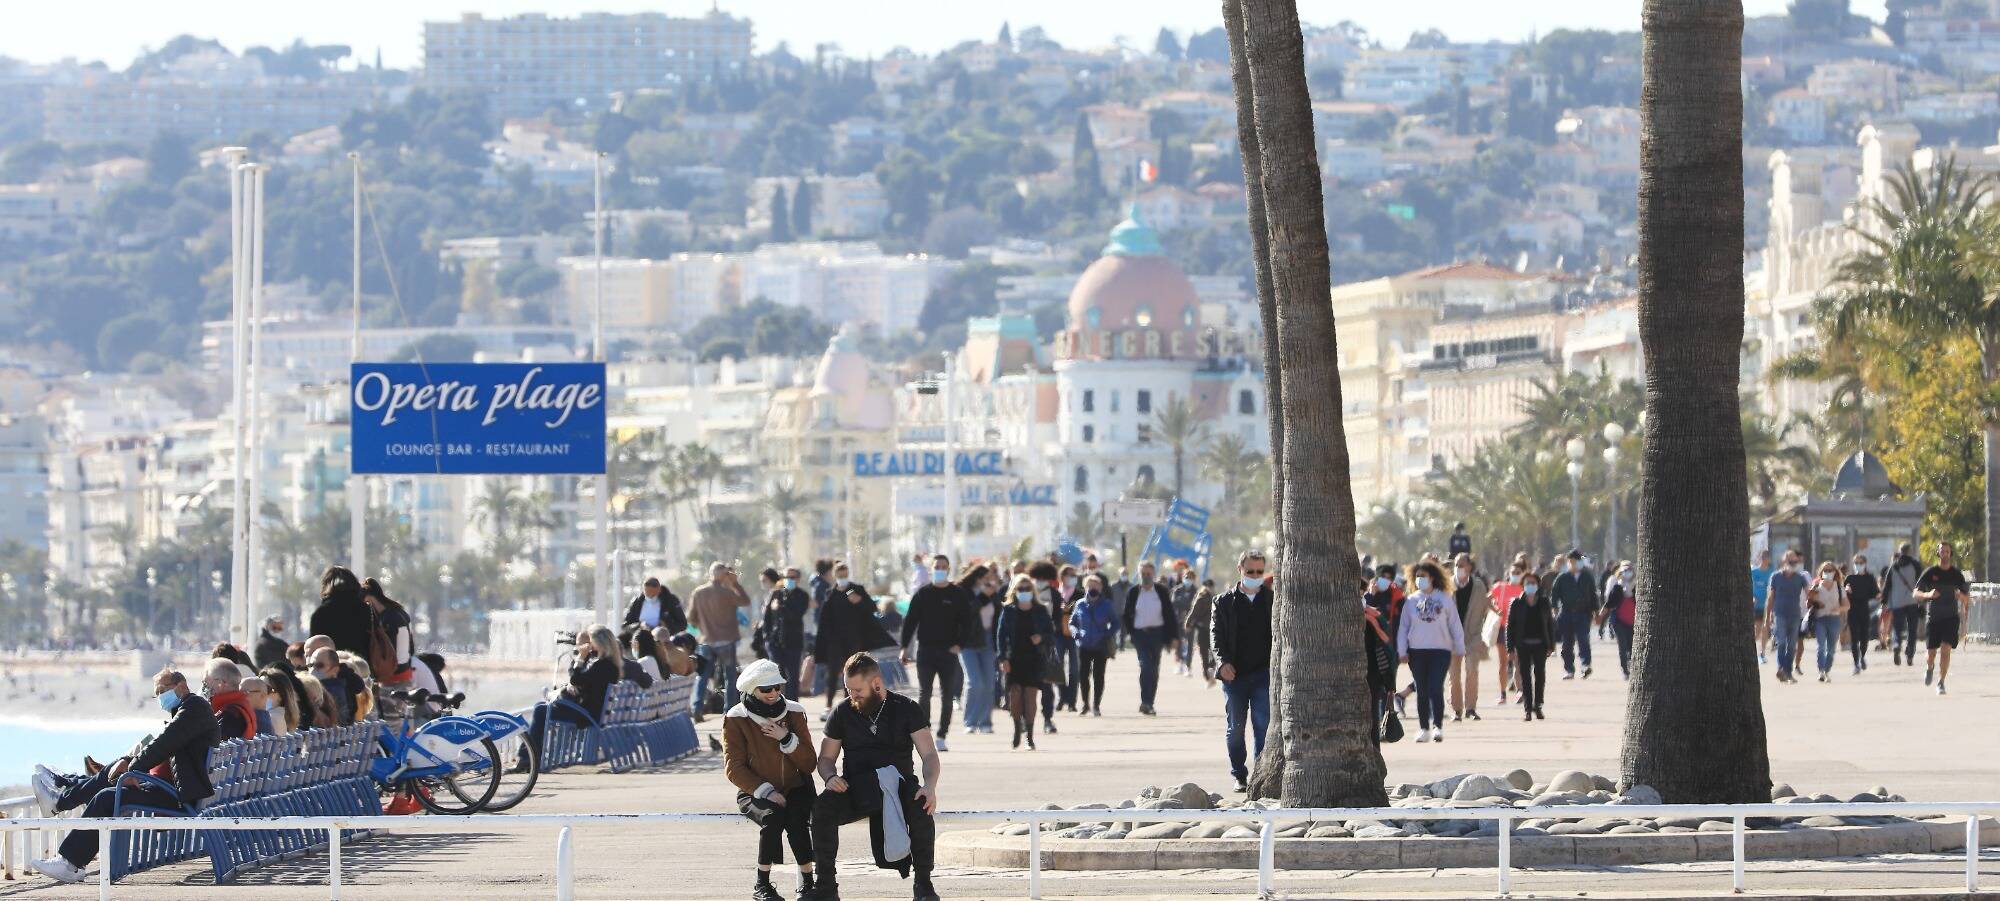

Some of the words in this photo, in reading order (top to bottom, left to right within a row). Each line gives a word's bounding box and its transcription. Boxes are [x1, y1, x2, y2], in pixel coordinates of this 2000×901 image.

[354, 372, 479, 426] Opera
[481, 367, 601, 428] plage
[386, 443, 442, 456] LOUNGE
[447, 443, 472, 456] BAR
[485, 443, 571, 456] RESTAURANT
[855, 452, 917, 476] BEAU
